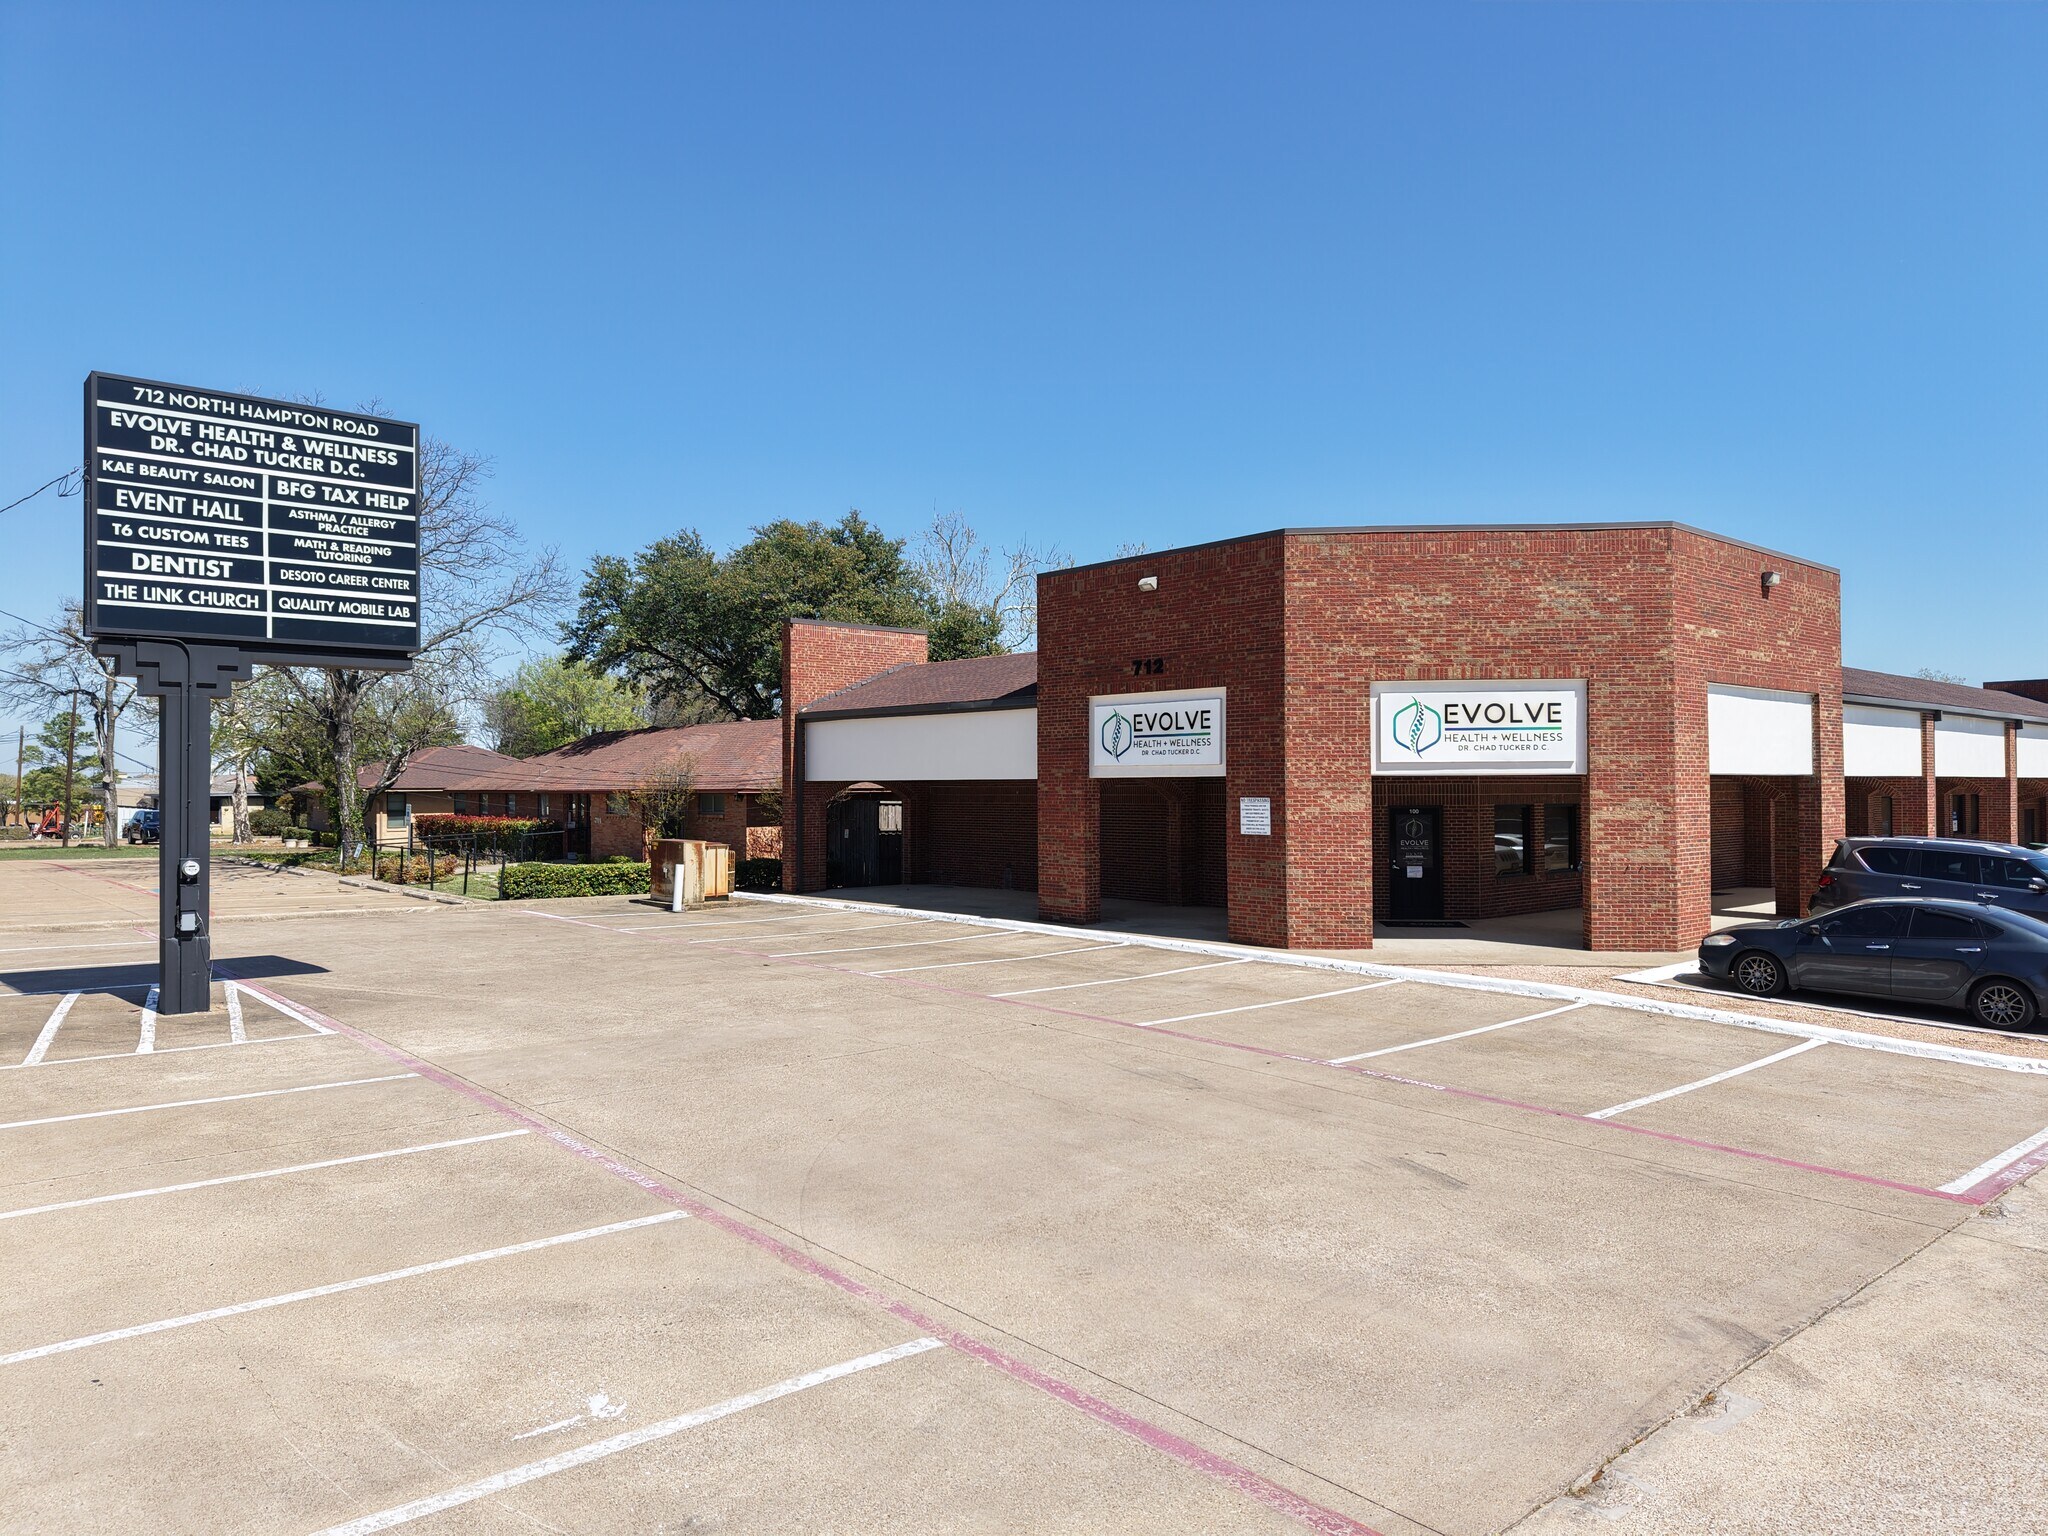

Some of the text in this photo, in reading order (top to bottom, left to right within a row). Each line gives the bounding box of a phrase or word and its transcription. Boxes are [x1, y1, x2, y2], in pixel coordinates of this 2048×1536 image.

[133, 386, 379, 437] 712 NORTH HAMPTON ROAD
[110, 410, 398, 466] EVOLVE HEALTH & WELLNESS
[150, 435, 366, 478] DR. CHAD TUCKER D.C.
[102, 459, 255, 490] KAE BEAUTY SALON
[116, 488, 244, 522] EVENT HALL
[277, 479, 410, 511] BFG TAX HELP
[288, 509, 338, 523] ASTHMA
[349, 516, 397, 530] ALLERGY
[318, 522, 369, 536] PRACTICE
[111, 522, 250, 549] T6 CUSTOM TEES
[293, 538, 392, 557] MATH & READING
[314, 549, 373, 564] TUTORING
[132, 552, 234, 579] DENTIST
[280, 568, 410, 591] DESOTO CAREER CENTER
[103, 583, 259, 609] THE LINK CHURCH
[278, 596, 411, 618] QUALITY MOBILE LAB
[1132, 658, 1164, 676] 712
[1133, 709, 1211, 732] EVOLVE
[1444, 702, 1562, 724] EVOLVE
[1133, 740, 1162, 748] HEALTH
[1169, 737, 1212, 747] WELLNESS
[1444, 733, 1489, 743] HEALTH
[1501, 732, 1563, 742] WELLNESS
[1168, 748, 1190, 756] TUCKER
